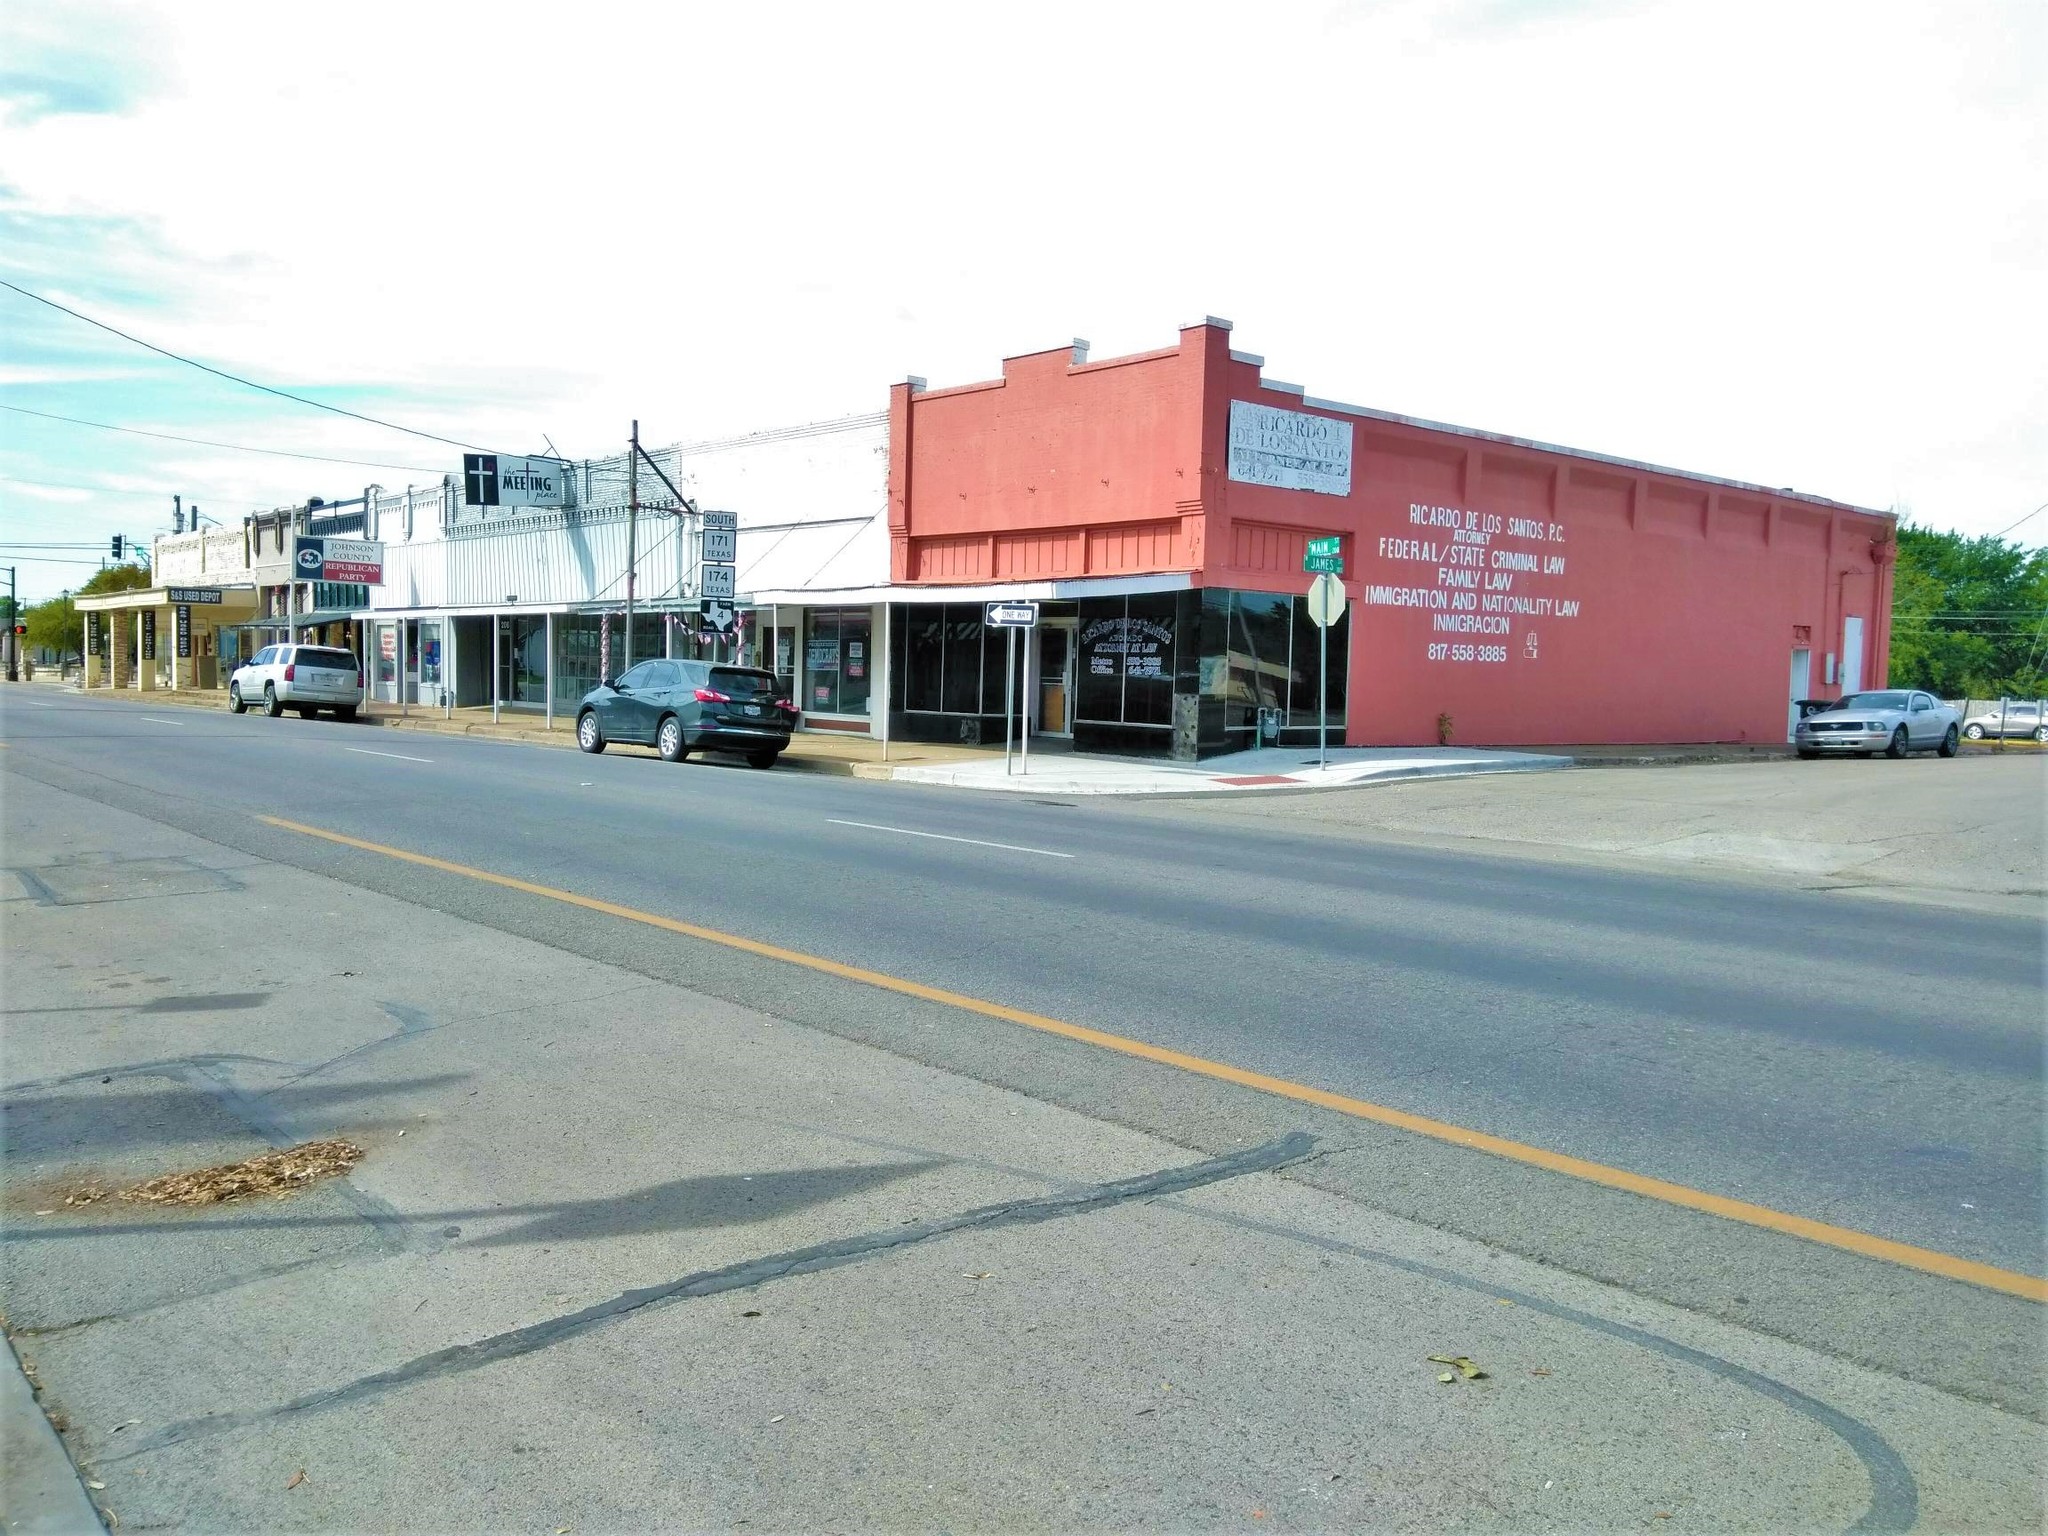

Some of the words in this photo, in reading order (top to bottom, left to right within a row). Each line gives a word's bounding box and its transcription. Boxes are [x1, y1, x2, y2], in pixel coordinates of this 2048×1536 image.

[504, 466, 516, 475] the
[503, 473, 551, 496] MEETING
[535, 490, 558, 502] place
[705, 513, 735, 525] SOUTH
[1409, 503, 1460, 529] RICARDO
[1465, 511, 1478, 531] DE
[1482, 514, 1502, 534] LOS
[1549, 523, 1565, 543] P.C.
[711, 535, 728, 546] 171
[1453, 529, 1491, 545] ATTORNEY
[330, 543, 374, 552] JOHNSON
[1311, 541, 1328, 556] MAIN
[333, 552, 373, 562] COUNTY
[707, 549, 731, 558] TEXAS
[1379, 537, 1485, 567] FEDERAL/STATE
[1491, 551, 1538, 573] CRIMINAL
[1544, 556, 1565, 574] LAW
[325, 562, 380, 573] REPUBLICAN
[1310, 557, 1334, 571] JAMES
[339, 573, 366, 581] PARTY
[708, 571, 728, 582] 174
[1438, 567, 1480, 589] FAMILY
[1484, 572, 1513, 592] LAW
[706, 585, 730, 594] TEXAS
[170, 590, 183, 600] S&S
[183, 591, 199, 602] USED
[200, 592, 220, 603] DEPOT
[1365, 585, 1447, 609] IMMIGRATION
[1451, 592, 1477, 611] AND
[1482, 594, 1553, 615] NATIONALITY
[1555, 599, 1580, 617] LAW
[717, 611, 724, 620] 4
[1002, 610, 1015, 619] ONE
[1017, 611, 1030, 619] WAY
[1433, 613, 1510, 635] INMIGRACION
[1108, 634, 1143, 642] ABOADO
[1091, 665, 1114, 674] Office
